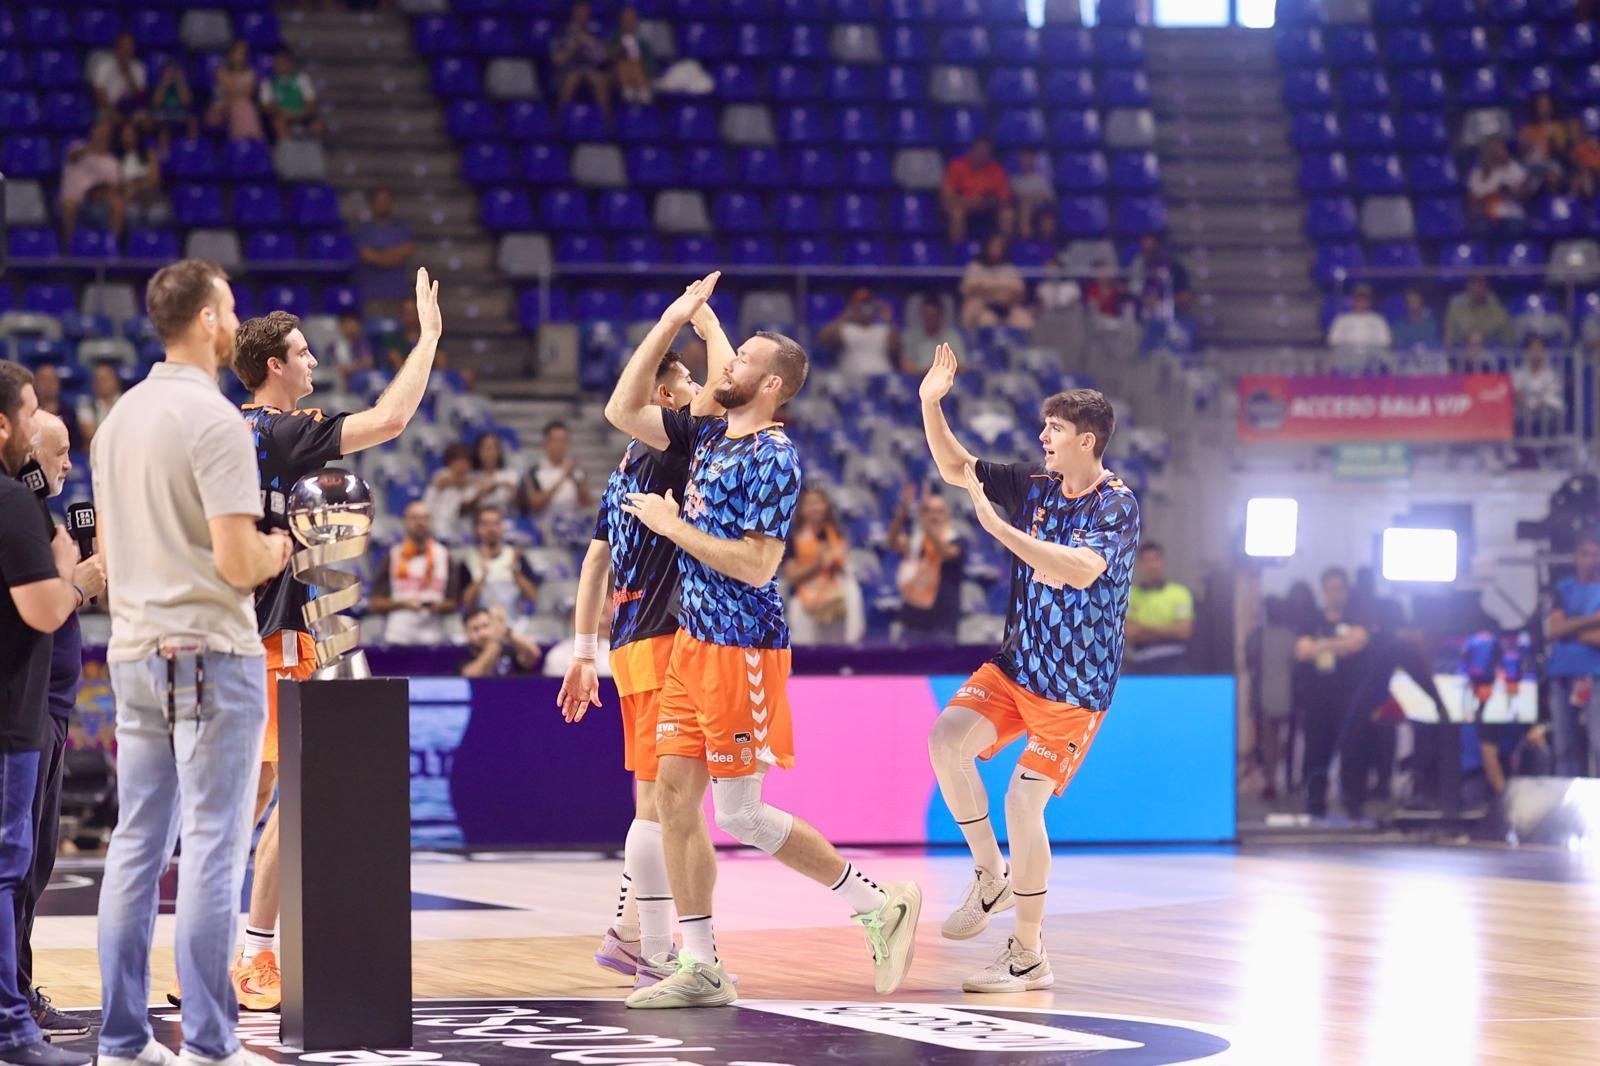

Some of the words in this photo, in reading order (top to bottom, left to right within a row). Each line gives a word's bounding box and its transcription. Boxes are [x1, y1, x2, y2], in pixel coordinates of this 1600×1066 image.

[1291, 394, 1375, 418] ACCESO
[1378, 394, 1431, 417] SALA
[1434, 394, 1471, 416] VIP
[657, 722, 675, 732] EVA
[706, 751, 734, 762] idea
